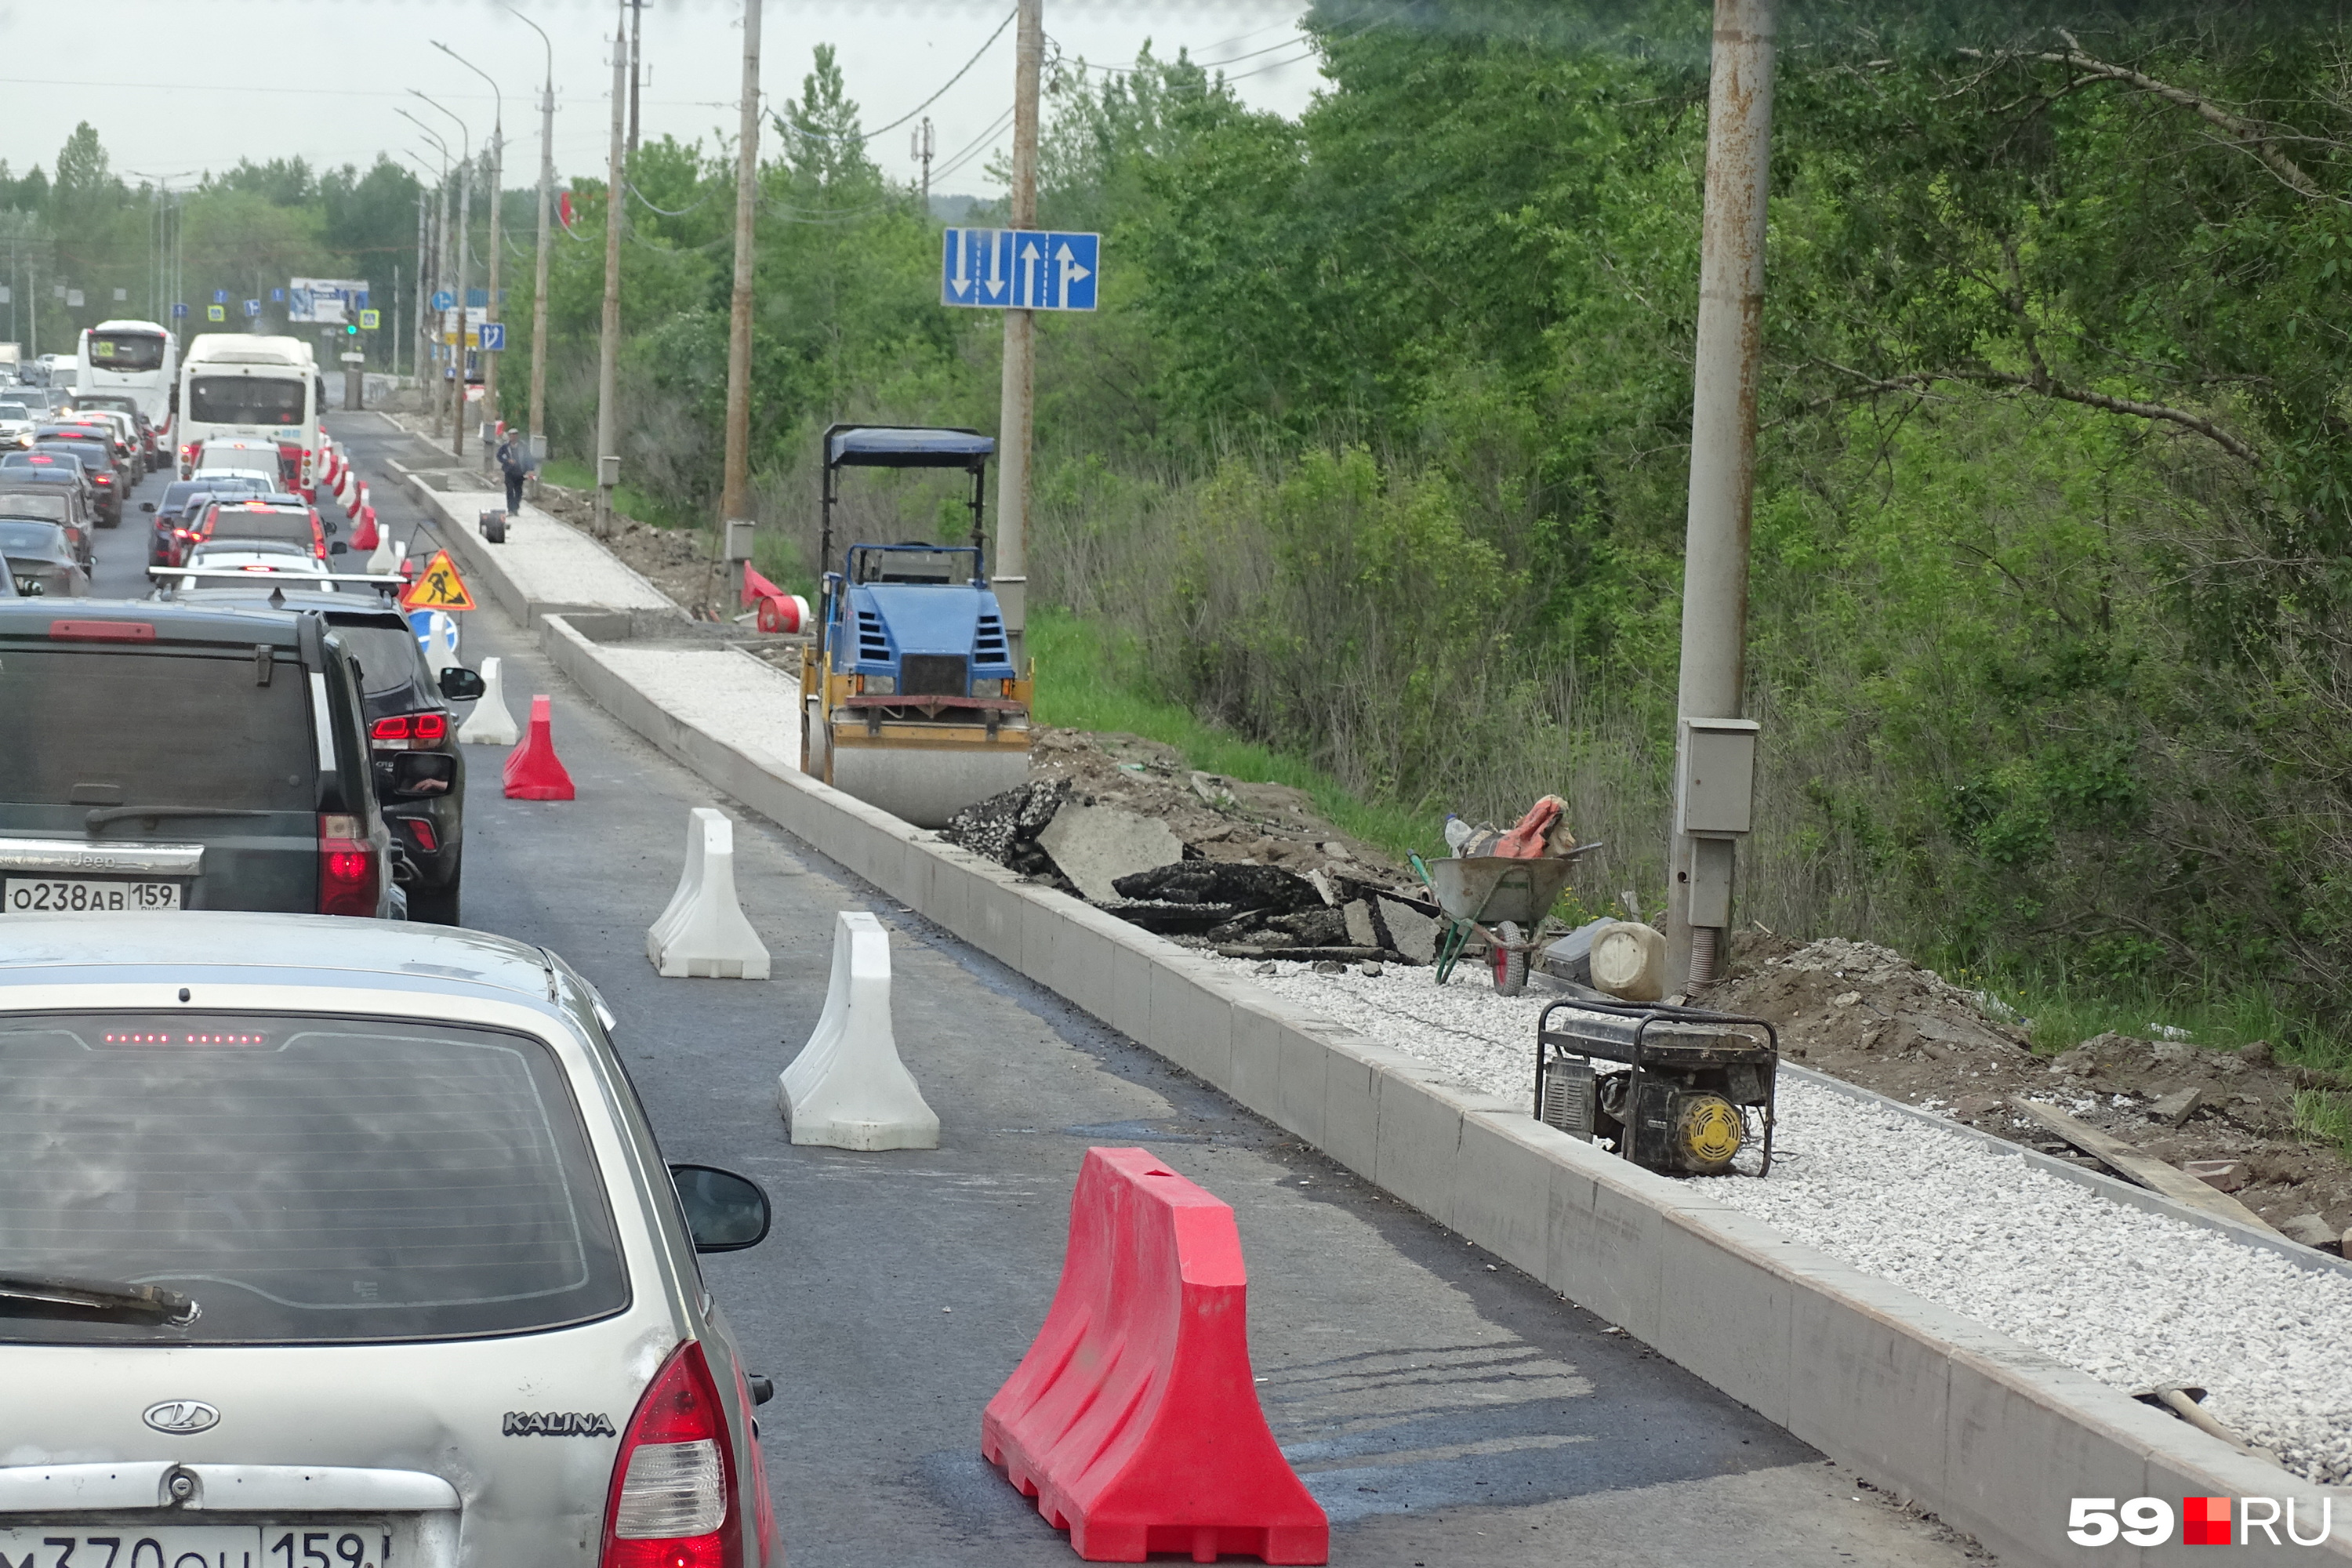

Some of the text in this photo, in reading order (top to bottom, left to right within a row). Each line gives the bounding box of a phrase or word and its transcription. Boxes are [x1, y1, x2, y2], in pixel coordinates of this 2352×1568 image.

[71, 852, 116, 869] Jeep
[132, 884, 172, 906] 159
[503, 1410, 616, 1438] KALINA
[271, 1533, 365, 1568] 159
